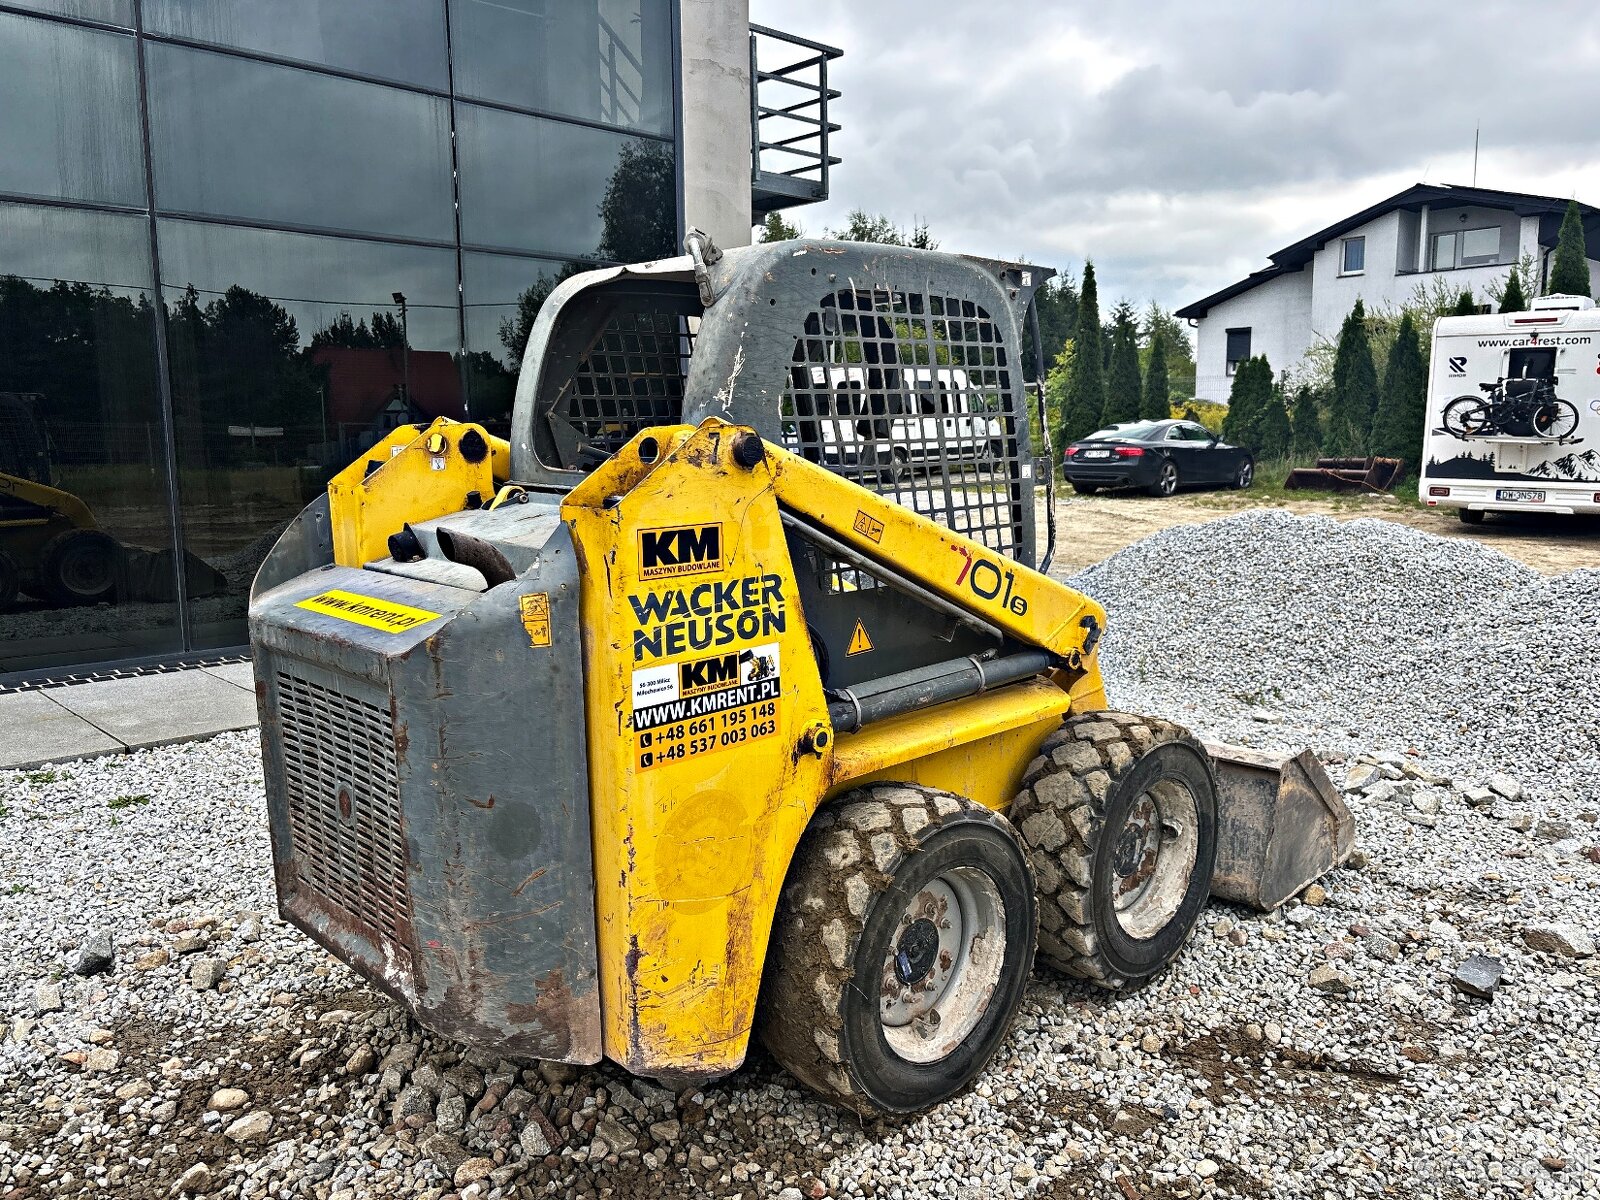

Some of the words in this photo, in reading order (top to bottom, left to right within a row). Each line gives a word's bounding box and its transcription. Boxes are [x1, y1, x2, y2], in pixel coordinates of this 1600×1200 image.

[1478, 336, 1591, 348] www.car4rest.com
[641, 526, 719, 568] KM
[643, 565, 676, 577] MASZYNY
[677, 561, 720, 573] BUDOWLANE
[312, 595, 428, 627] www.kmrent.pl
[627, 573, 786, 626] WACKER
[633, 605, 786, 662] NEUSON
[681, 653, 738, 690] KM
[634, 684, 779, 729] WWW.KMRENT.PL
[655, 726, 685, 744] +48
[689, 717, 715, 737] 661
[721, 709, 746, 730] 195
[751, 702, 775, 722] 148
[656, 744, 686, 763] +48
[690, 736, 716, 756] 537
[721, 728, 746, 747] 003
[751, 720, 775, 739] 063
